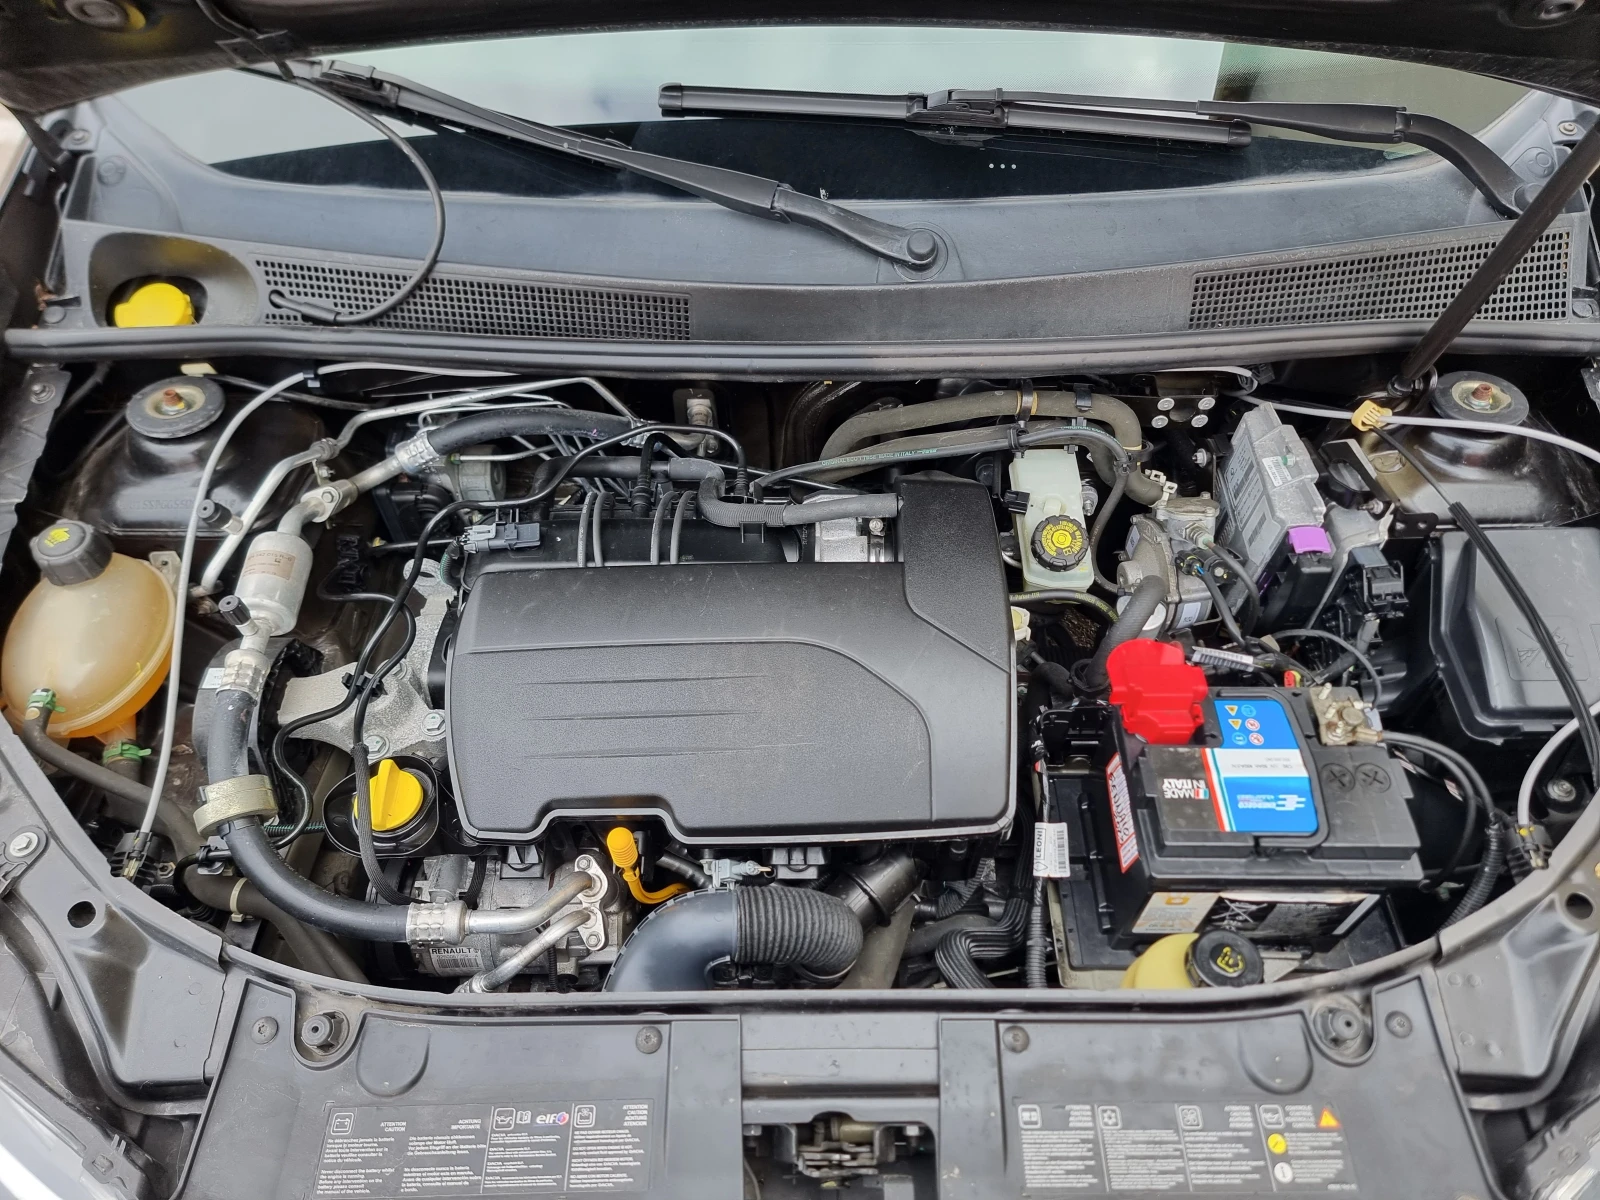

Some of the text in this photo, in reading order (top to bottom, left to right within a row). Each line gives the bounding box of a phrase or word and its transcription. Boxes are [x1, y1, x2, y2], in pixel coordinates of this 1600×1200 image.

[1162, 778, 1206, 789] IN ITALY
[1164, 788, 1194, 799] MADE
[536, 1113, 558, 1124] elf
